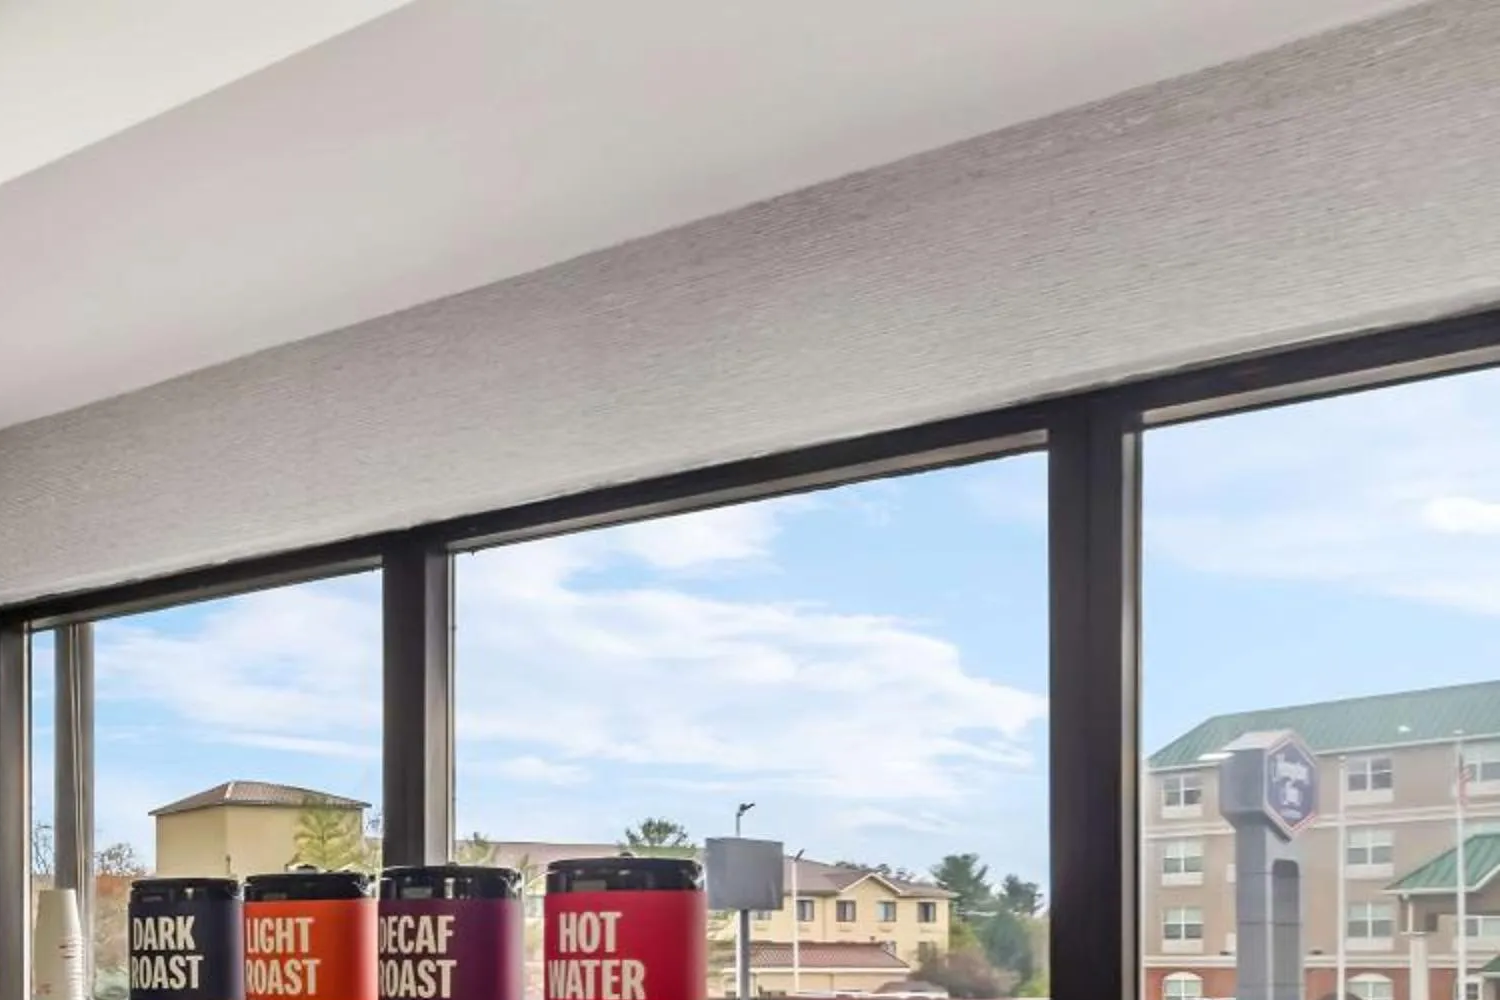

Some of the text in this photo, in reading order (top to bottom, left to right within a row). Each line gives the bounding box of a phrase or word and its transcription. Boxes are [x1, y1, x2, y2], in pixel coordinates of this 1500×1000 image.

[133, 915, 196, 951] DARK
[246, 916, 315, 953] LIGHT
[379, 915, 455, 954] DECAF
[558, 911, 623, 954] HOT
[131, 955, 204, 990] ROAST
[245, 958, 322, 995] ROAST
[547, 959, 646, 1000] WATER
